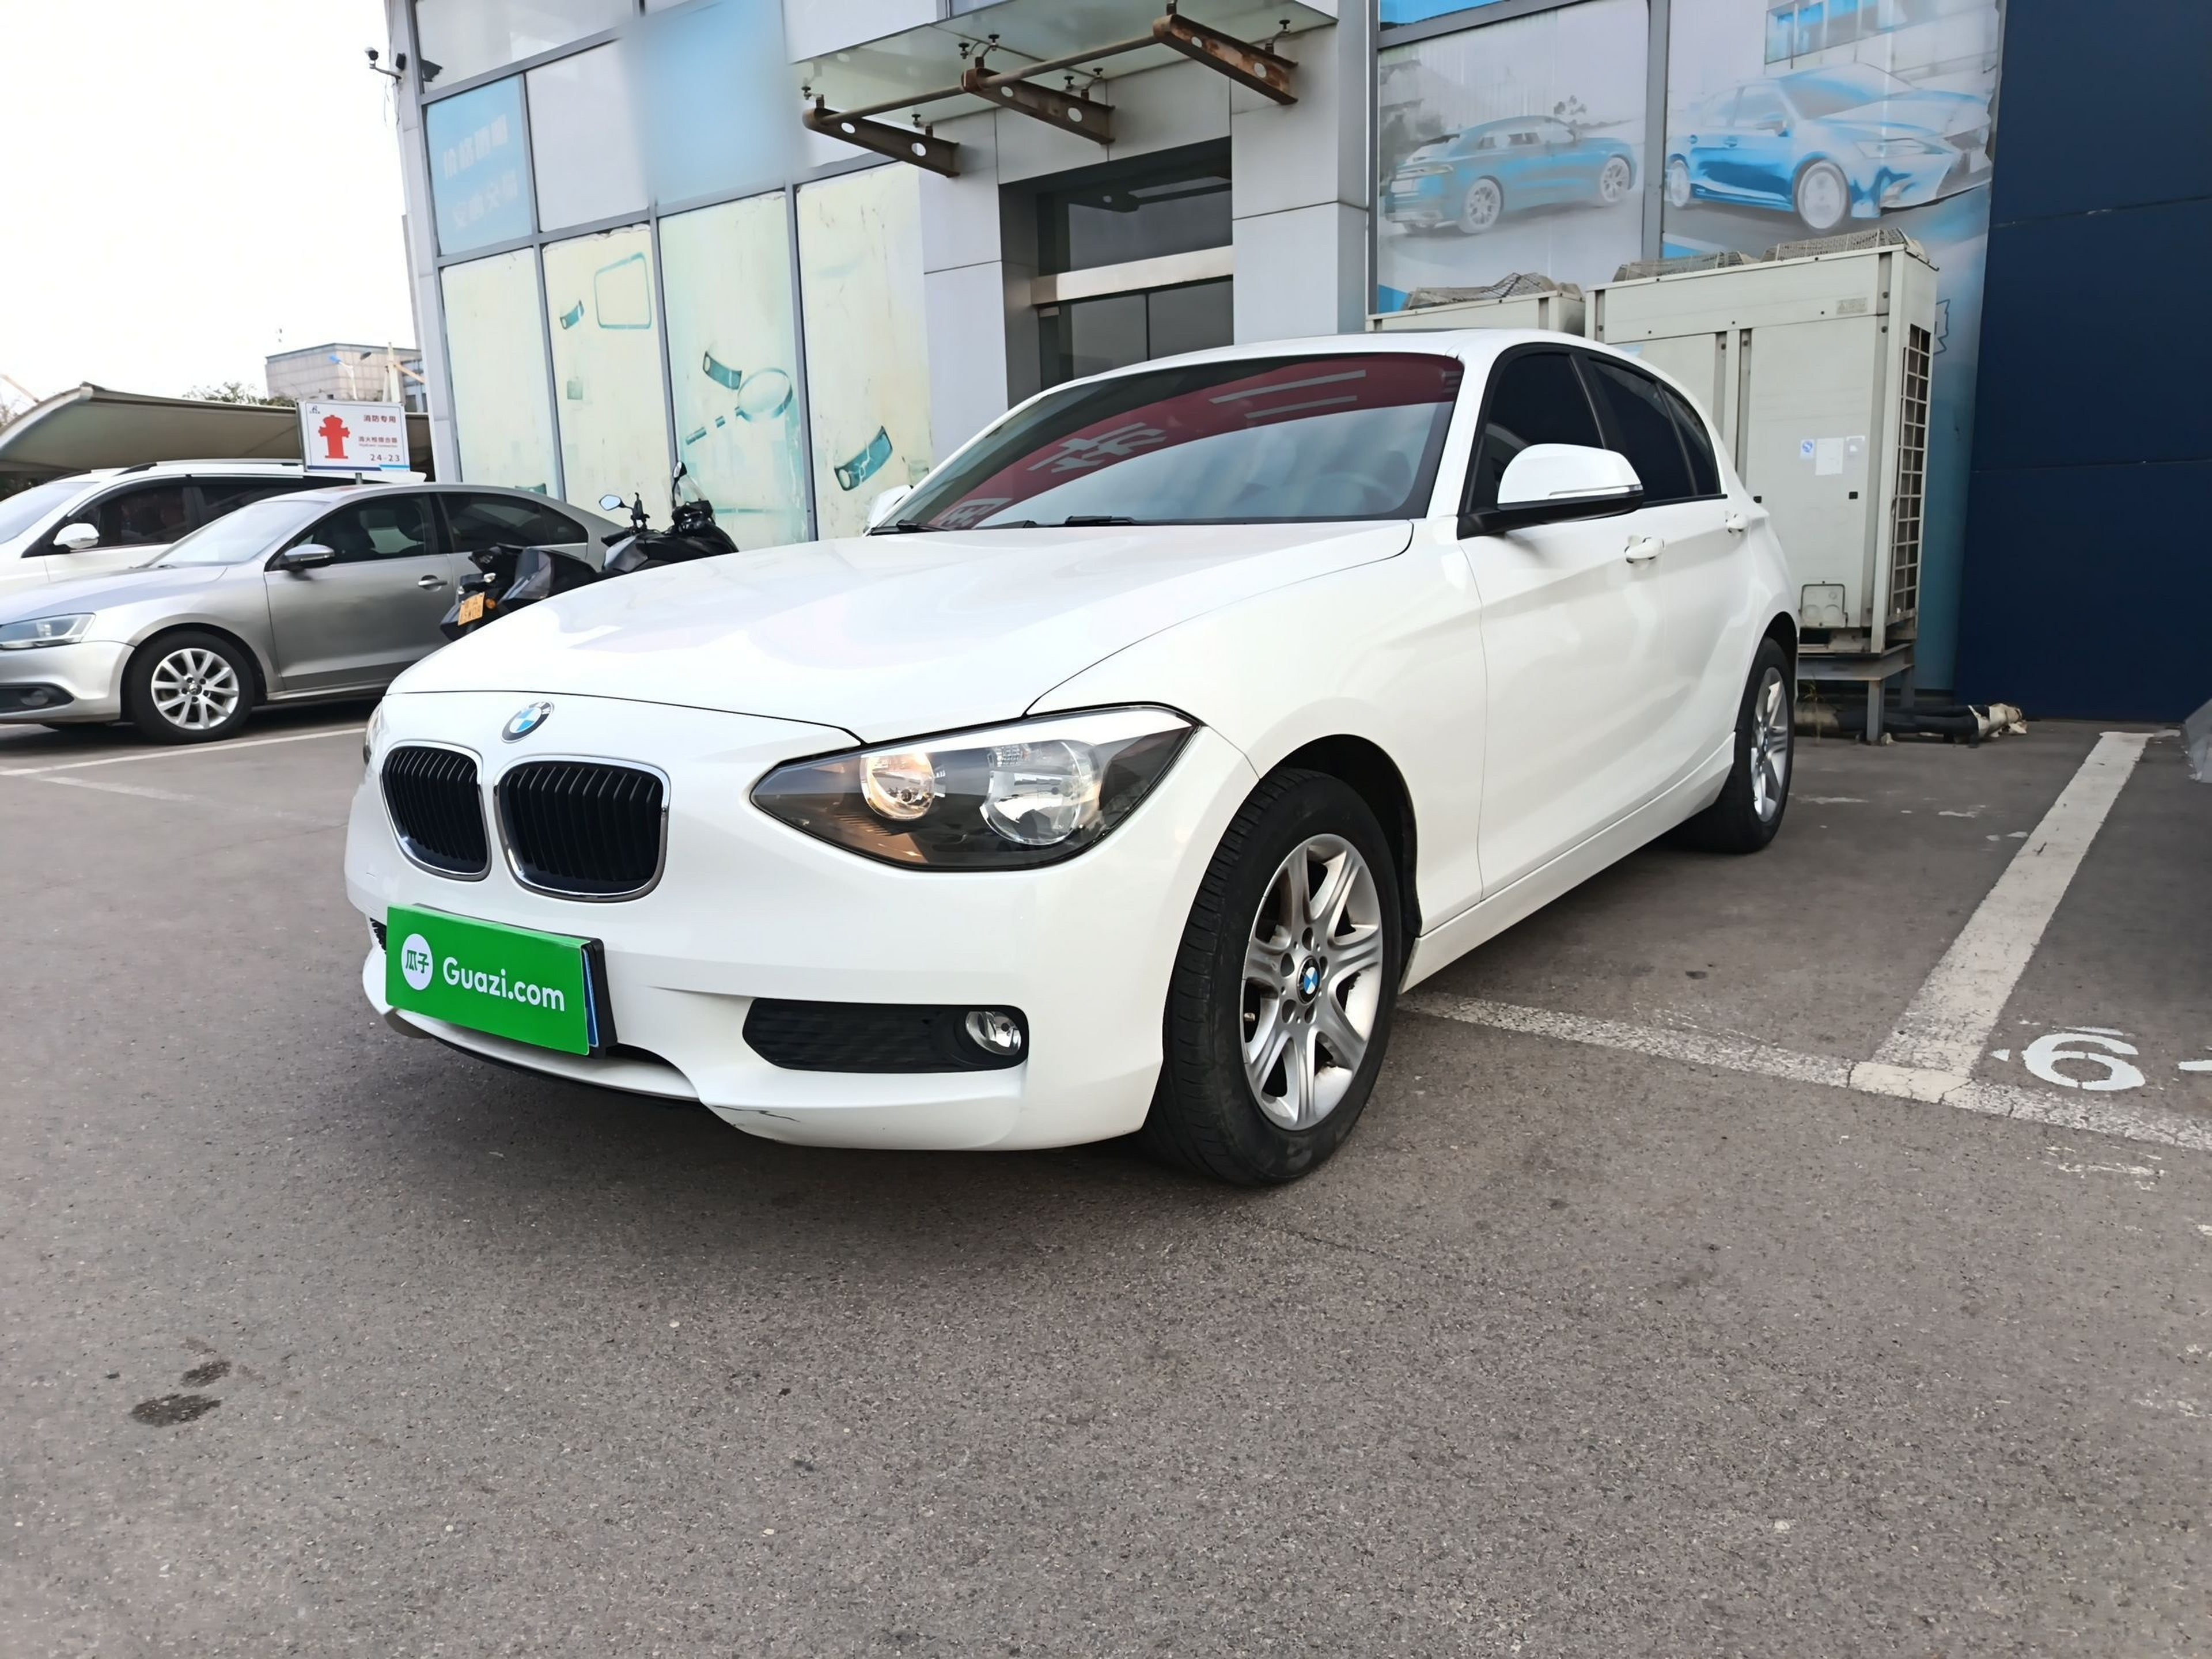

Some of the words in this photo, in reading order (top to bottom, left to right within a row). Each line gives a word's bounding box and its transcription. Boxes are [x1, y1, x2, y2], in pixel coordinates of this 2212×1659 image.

[363, 414, 396, 423] 消防专用
[405, 949, 430, 974] 瓜子
[442, 956, 565, 1012] Guazi.com
